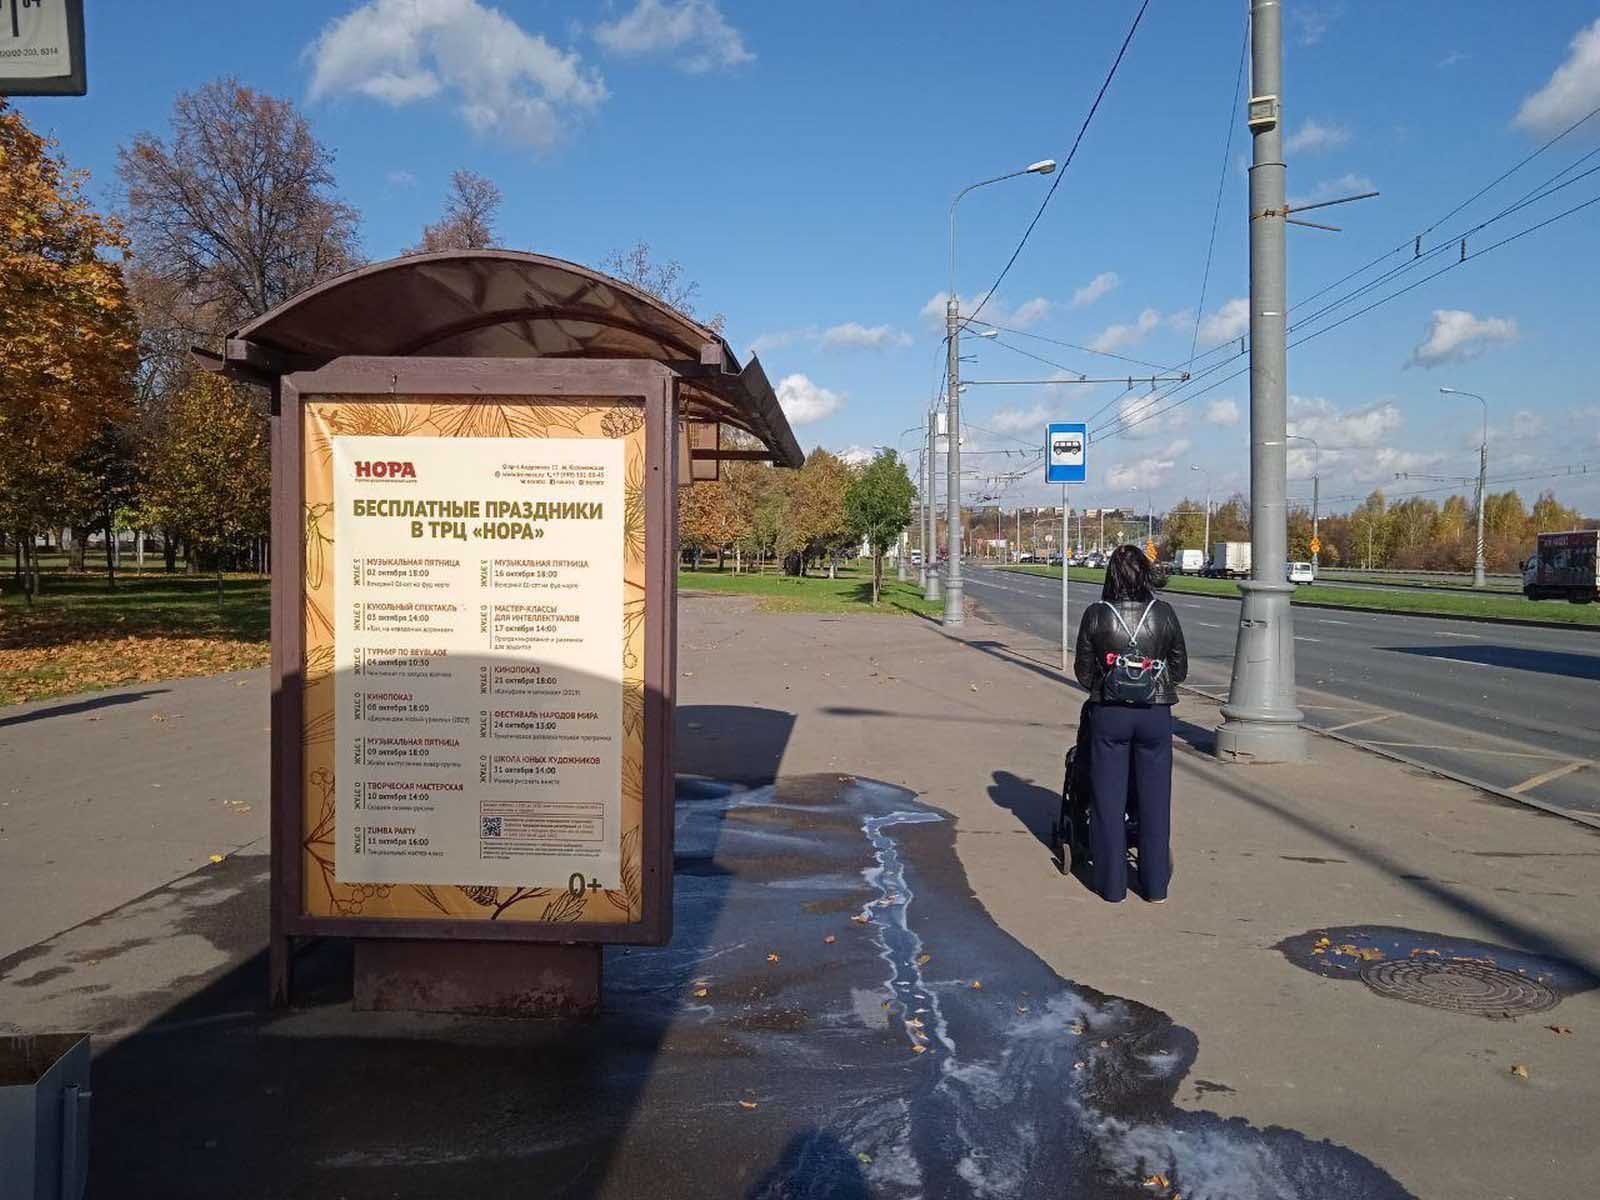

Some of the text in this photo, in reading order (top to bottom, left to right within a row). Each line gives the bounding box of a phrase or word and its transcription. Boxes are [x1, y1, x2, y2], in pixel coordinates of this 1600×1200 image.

[354, 460, 417, 478] НОРА
[353, 499, 603, 521] БЕСПЛАТНЫЕ ПРАЗДНИКИ
[411, 521, 544, 541] В ТРЦ «НОРА»
[424, 559, 460, 568] ПЯТНИЦА
[480, 566, 488, 587] ЭТАЖ
[506, 570, 535, 578] октября
[367, 602, 413, 611] КУКОЛЬНЫЙ
[378, 614, 406, 622] октября
[505, 624, 534, 633] октября
[505, 677, 534, 685] октября
[505, 766, 533, 774] октября
[378, 793, 406, 801] октября
[378, 838, 406, 846] октября
[568, 872, 602, 898] 0+
